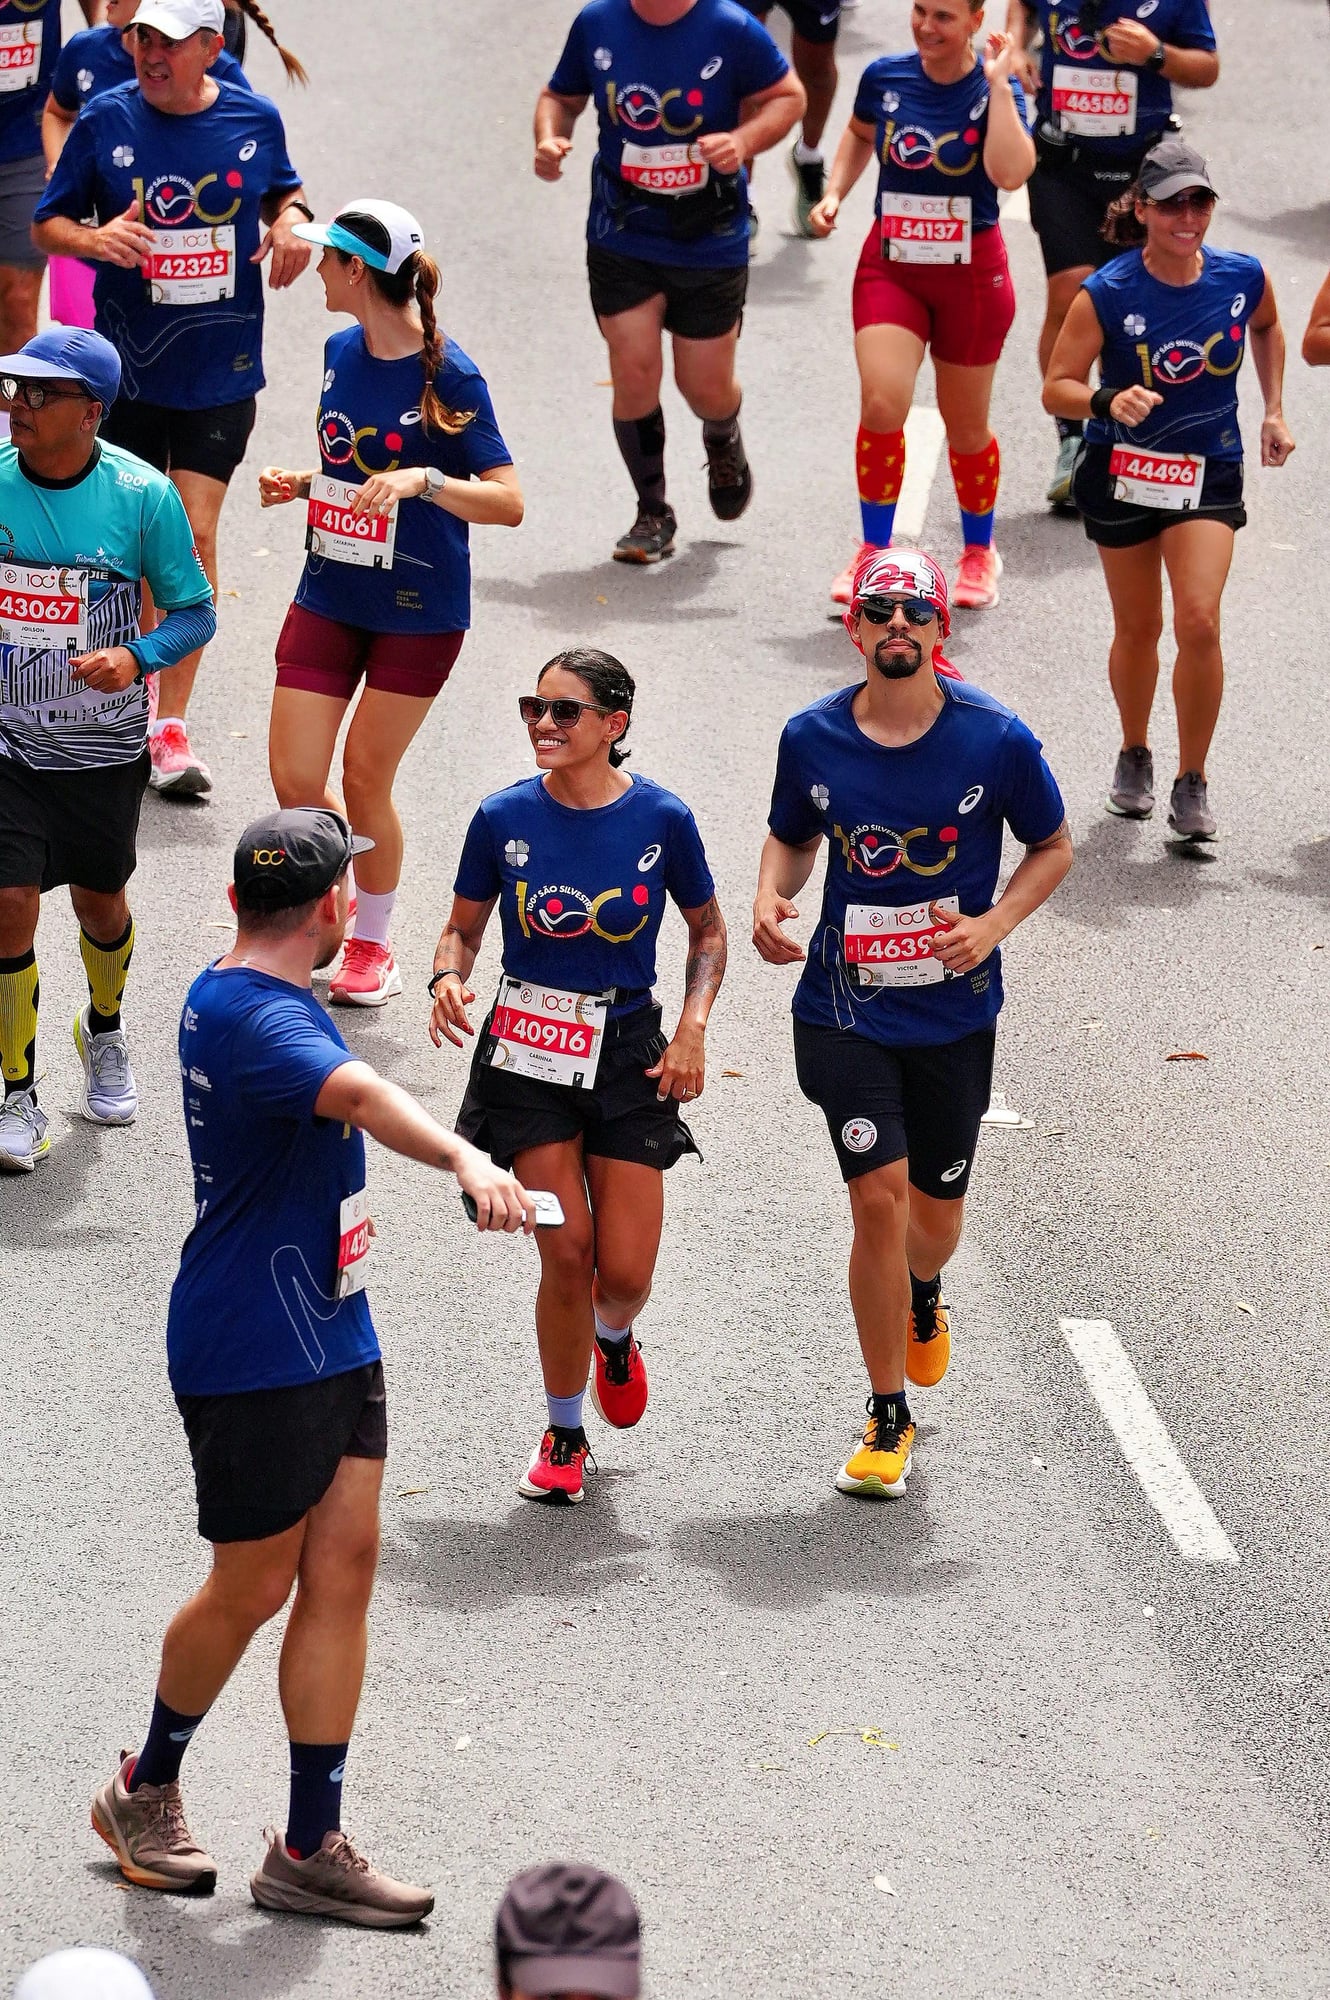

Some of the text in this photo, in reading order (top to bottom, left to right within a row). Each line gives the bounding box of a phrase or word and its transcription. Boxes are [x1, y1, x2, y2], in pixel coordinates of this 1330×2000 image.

[1066, 93, 1127, 114] 46586
[638, 168, 696, 187] 43961
[900, 220, 959, 240] 54137
[160, 255, 225, 277] 42325
[324, 410, 338, 420] SÃO
[1127, 458, 1194, 484] 44496
[321, 509, 378, 538] 41061
[0, 595, 76, 621] 43067
[68, 638, 76, 646] M
[853, 825, 869, 836] SÃO
[870, 824, 904, 845] SILVESTRE
[538, 885, 557, 898] SÃO
[559, 885, 594, 912] SILVESTRE
[512, 1018, 586, 1052] 40916
[575, 1073, 582, 1082] F
